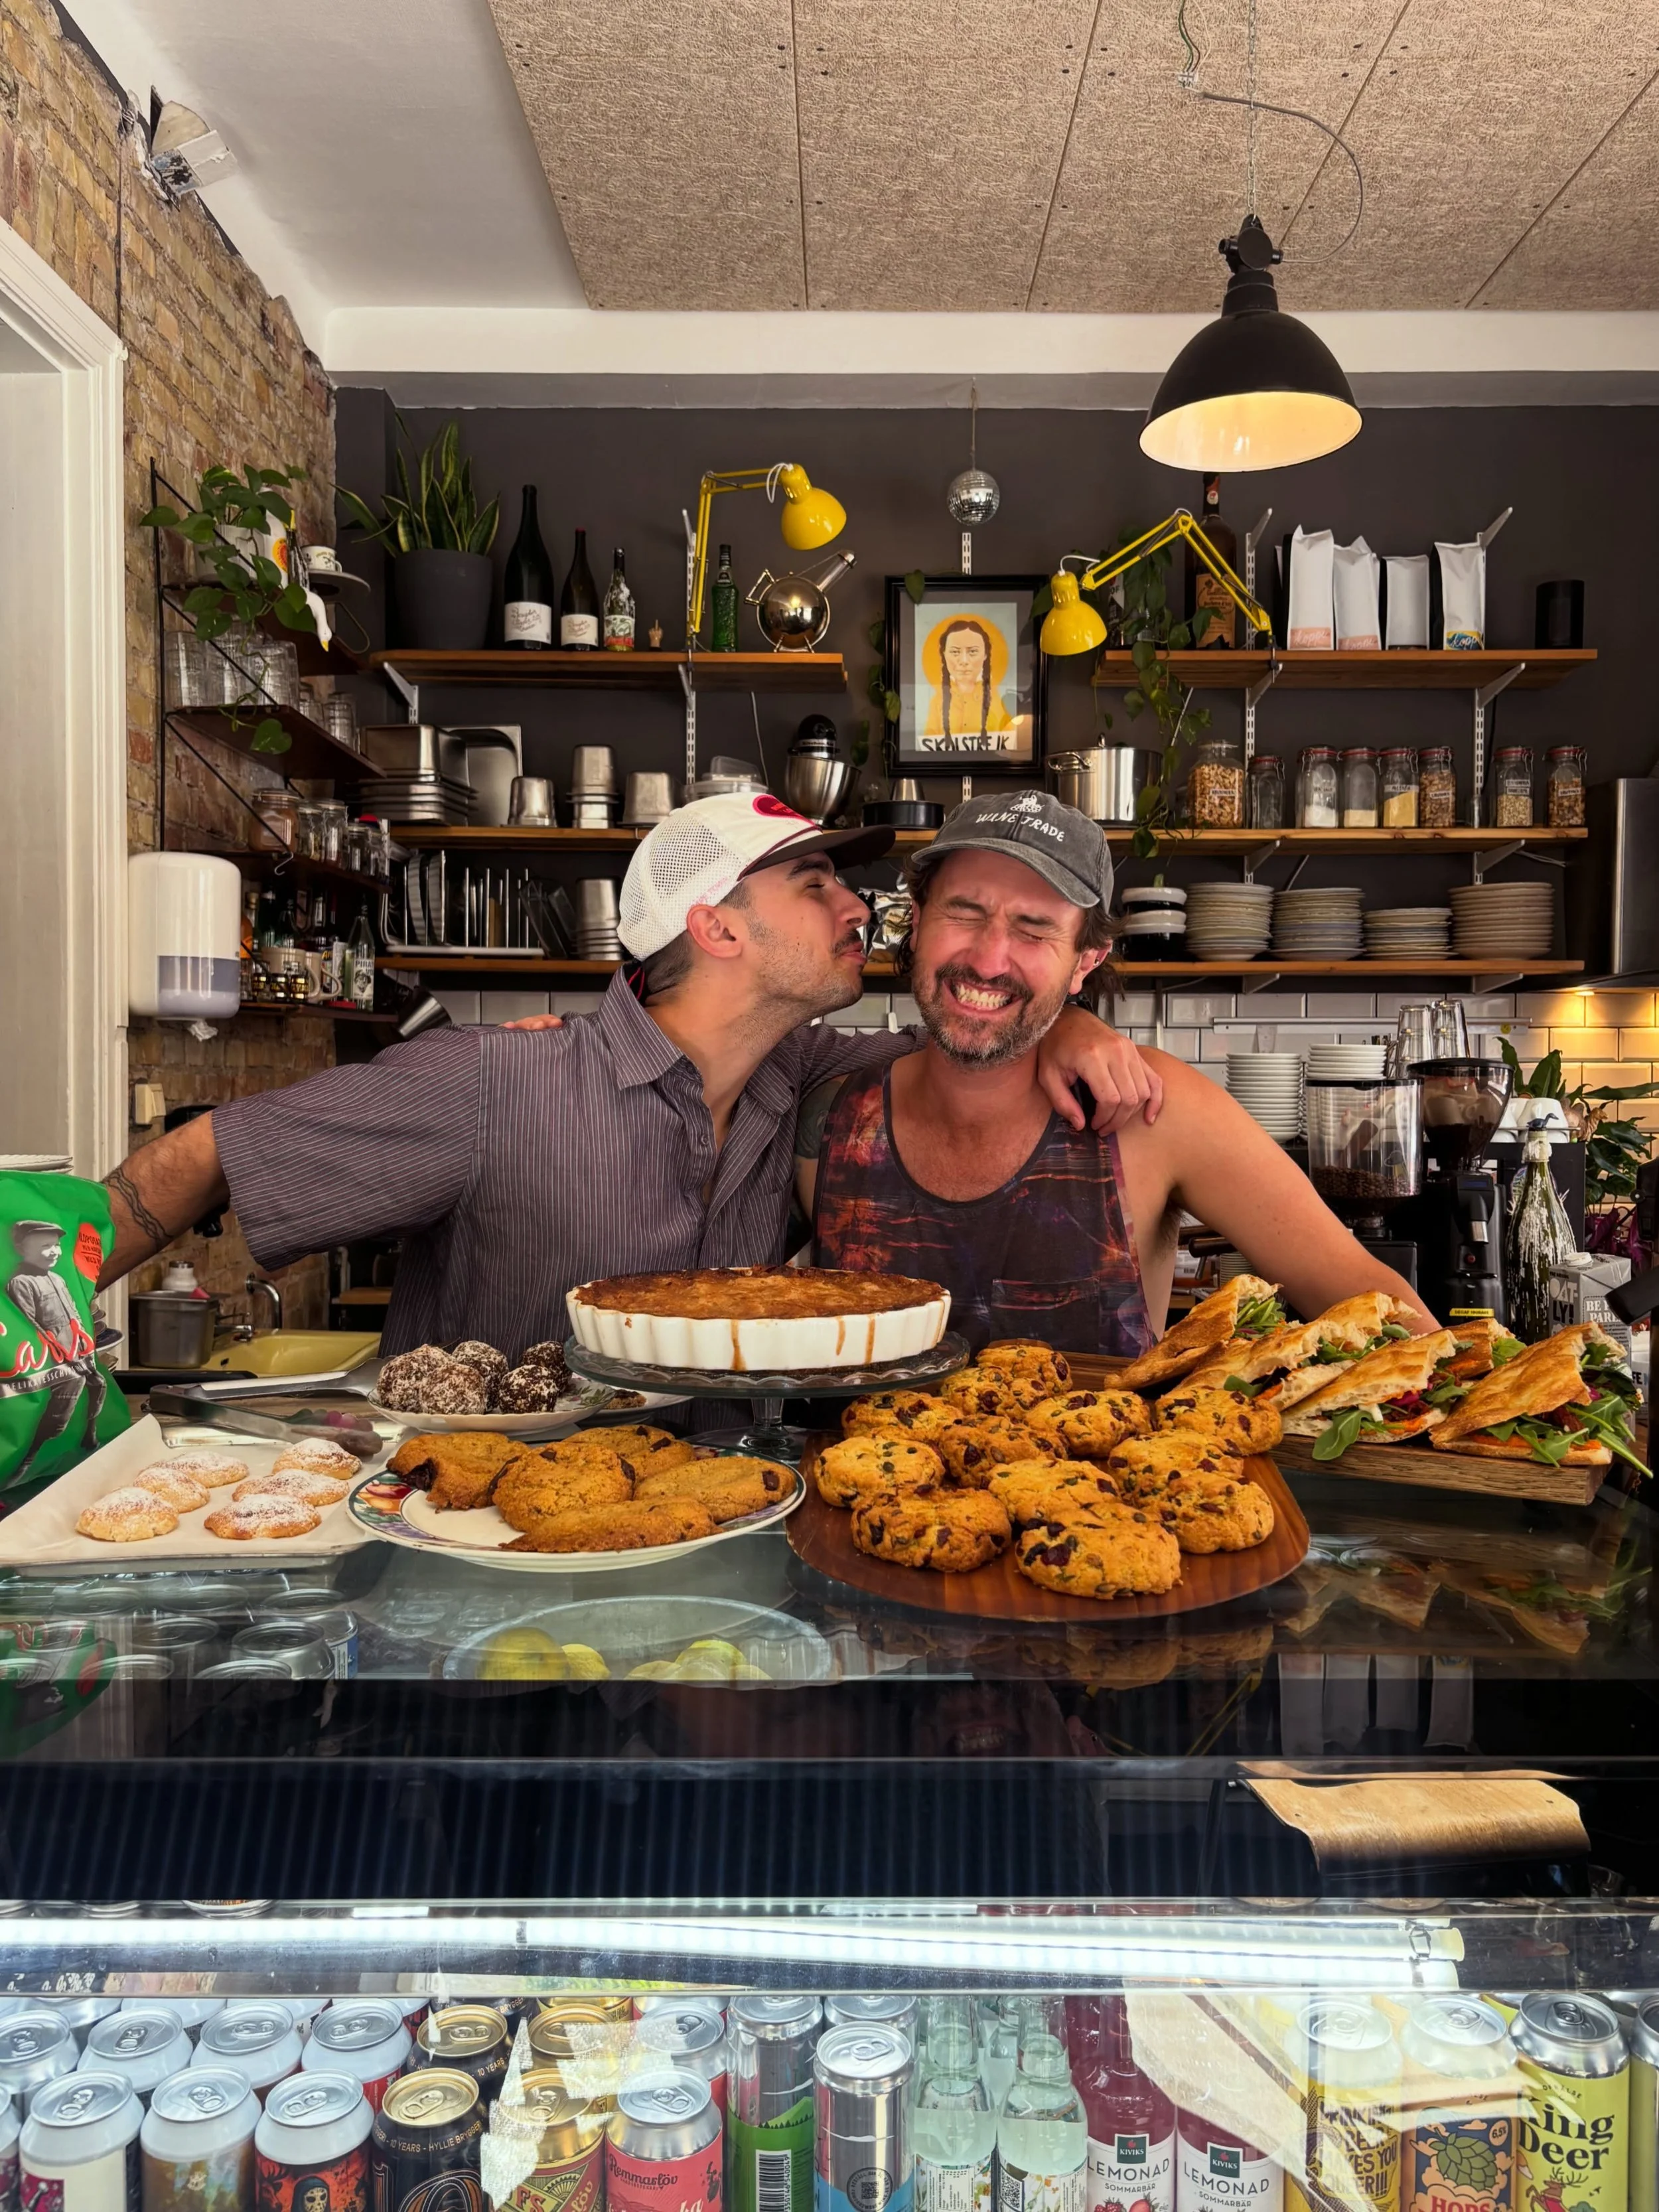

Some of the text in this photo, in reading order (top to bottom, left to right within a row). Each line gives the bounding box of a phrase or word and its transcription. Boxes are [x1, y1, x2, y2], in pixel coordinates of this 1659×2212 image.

[975, 812, 1065, 842] WINE TRADE
[1553, 1300, 1574, 1325] LY!
[1585, 1300, 1601, 1311] BE
[477, 2057, 505, 2077] 10 YEARS
[390, 2139, 397, 2148] 10
[397, 2143, 421, 2153] YEARS
[428, 2138, 455, 2152] HYLLIE
[1377, 2141, 1398, 2170] YOU
[1518, 2120, 1609, 2170] Deer
[1087, 2155, 1169, 2181] LEMONAD
[1212, 2158, 1238, 2170] KIVIKS
[1104, 2183, 1156, 2193] SOMMARBÄR
[1184, 2162, 1269, 2195] LEMONAD
[1198, 2191, 1252, 2207] SOMMARBÄR
